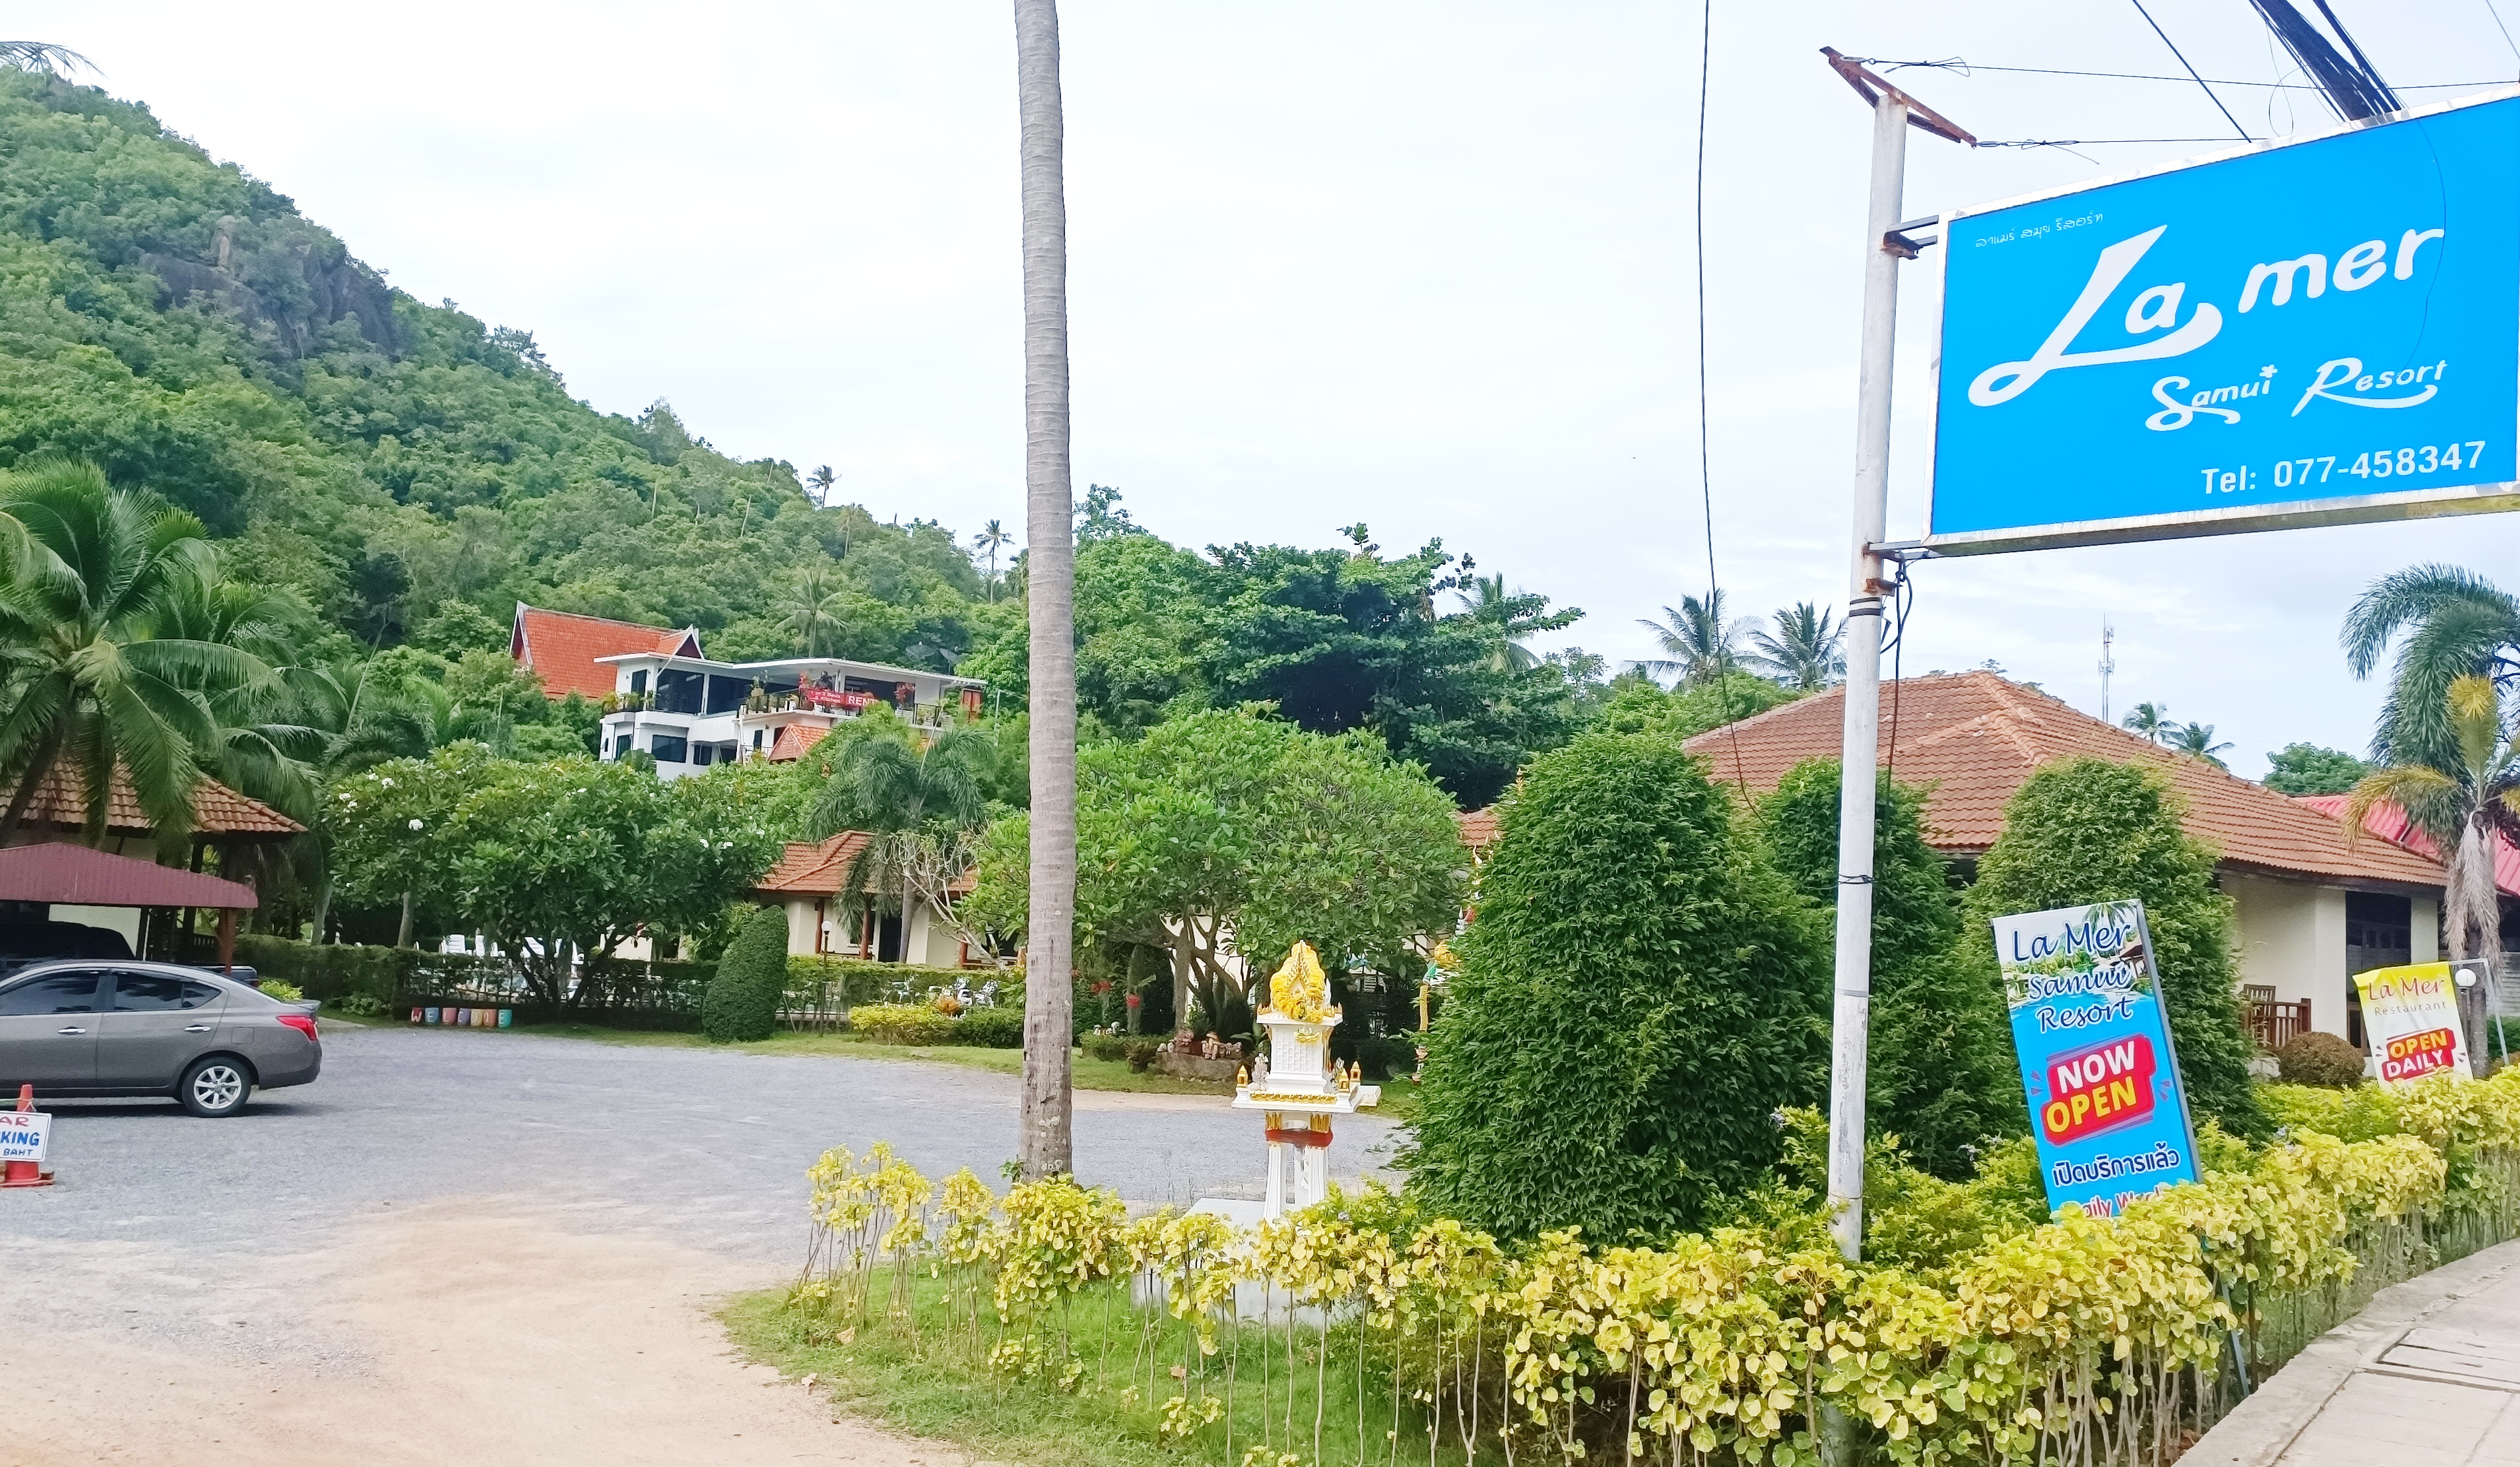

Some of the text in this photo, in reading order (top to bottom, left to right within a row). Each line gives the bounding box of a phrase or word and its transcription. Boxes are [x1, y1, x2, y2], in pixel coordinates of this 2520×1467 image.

[2020, 225, 2050, 240] สมุย
[1968, 224, 2445, 407] La mer
[2145, 357, 2448, 432] Samui Resort
[2201, 440, 2486, 494] Tel: 077-458347
[2012, 921, 2131, 963] La Mer
[2368, 976, 2445, 1001] La Mer
[410, 1009, 506, 1025] WELCOE
[2036, 996, 2135, 1033] Resort
[2374, 1001, 2447, 1017] Restaurant
[2390, 1031, 2447, 1059] OPEN
[2057, 1041, 2135, 1094] NOW
[2386, 1049, 2443, 1078] DAILY
[2046, 1076, 2137, 1132] OPEN
[0, 1116, 29, 1126] AR
[0, 1131, 40, 1146] KING
[2052, 1142, 2179, 1186] เปิดบริการแล้ว
[2082, 1196, 2112, 1218] aily
